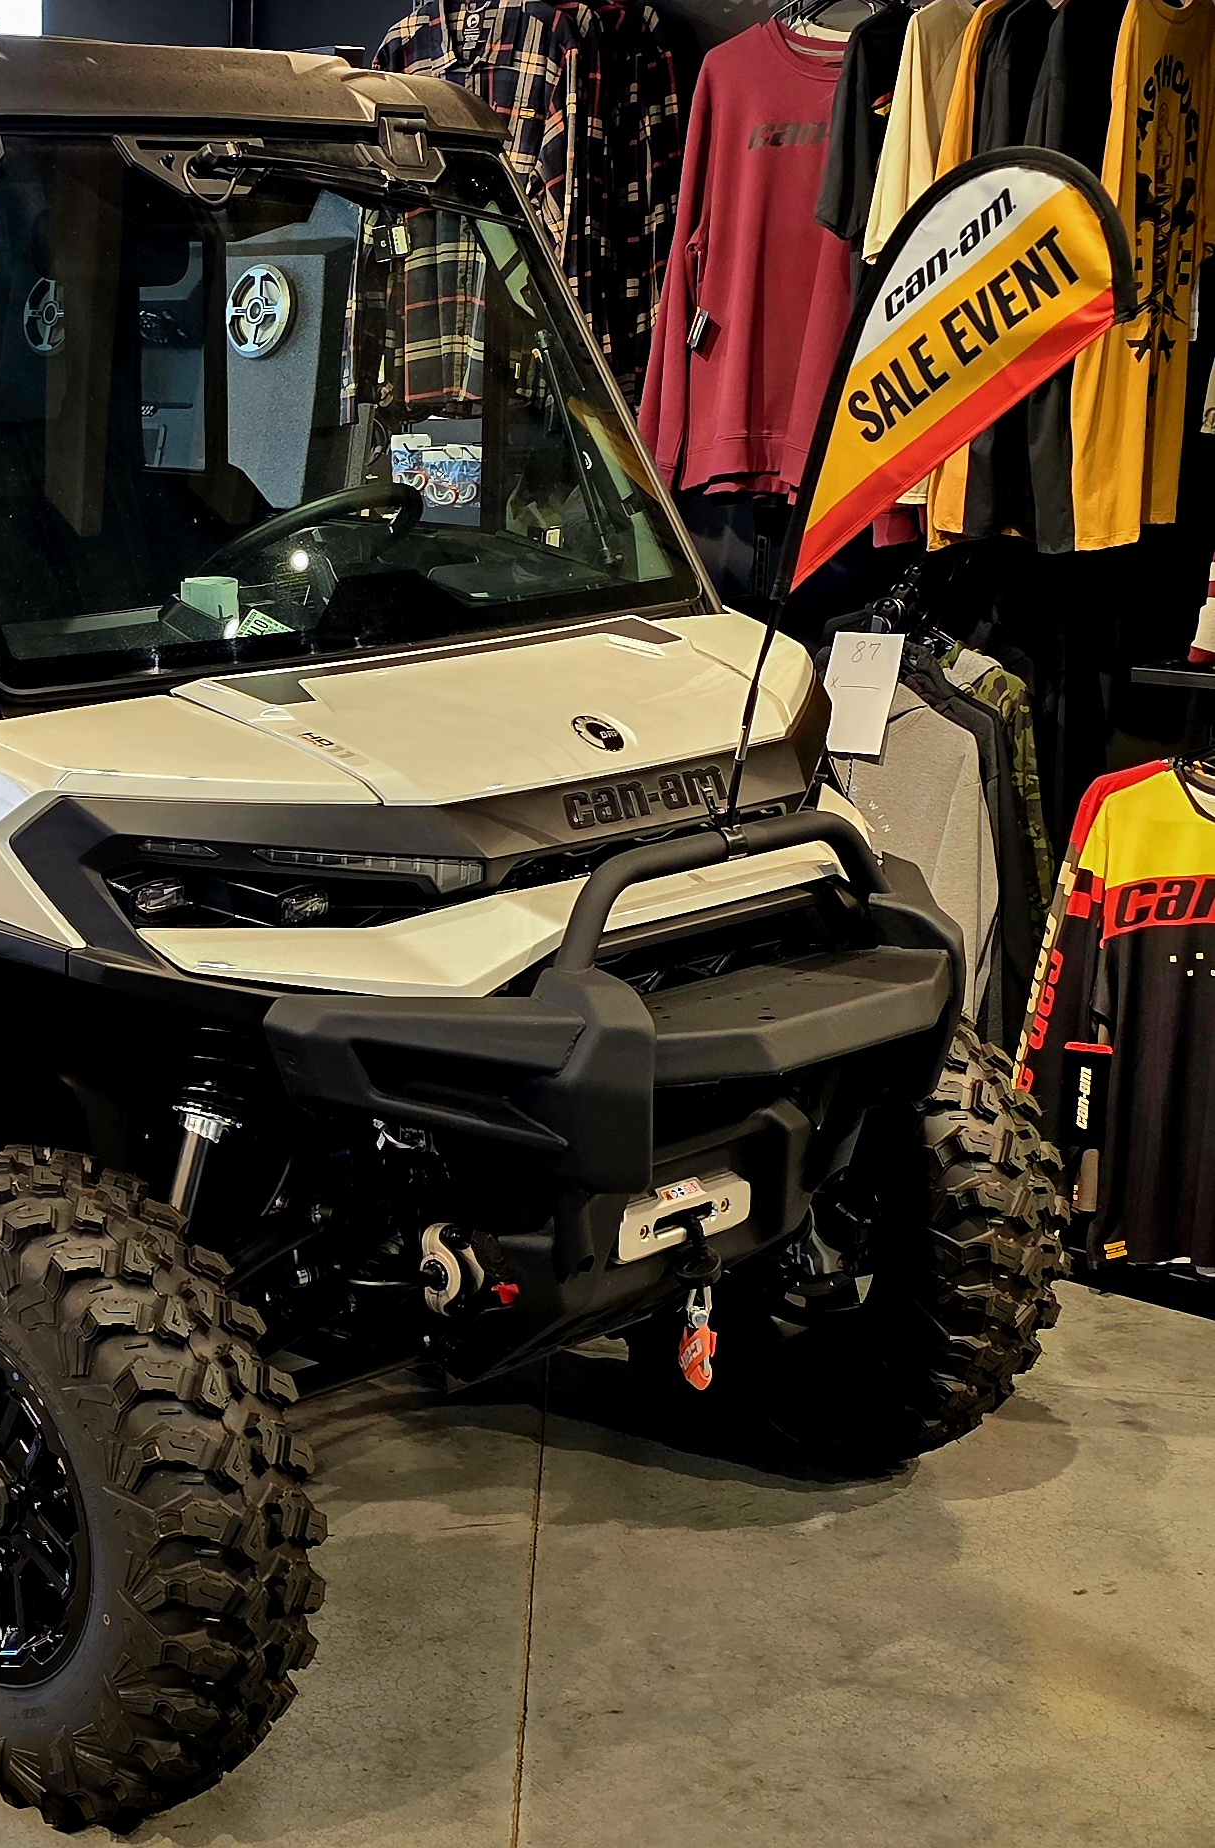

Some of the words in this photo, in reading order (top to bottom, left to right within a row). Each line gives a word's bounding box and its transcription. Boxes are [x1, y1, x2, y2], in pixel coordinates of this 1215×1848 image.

[848, 333, 951, 442] SALE
[939, 225, 1080, 367] EVENT
[851, 640, 882, 663] 87
[562, 764, 729, 831] can-am
[1075, 1066, 1093, 1130] can-am
